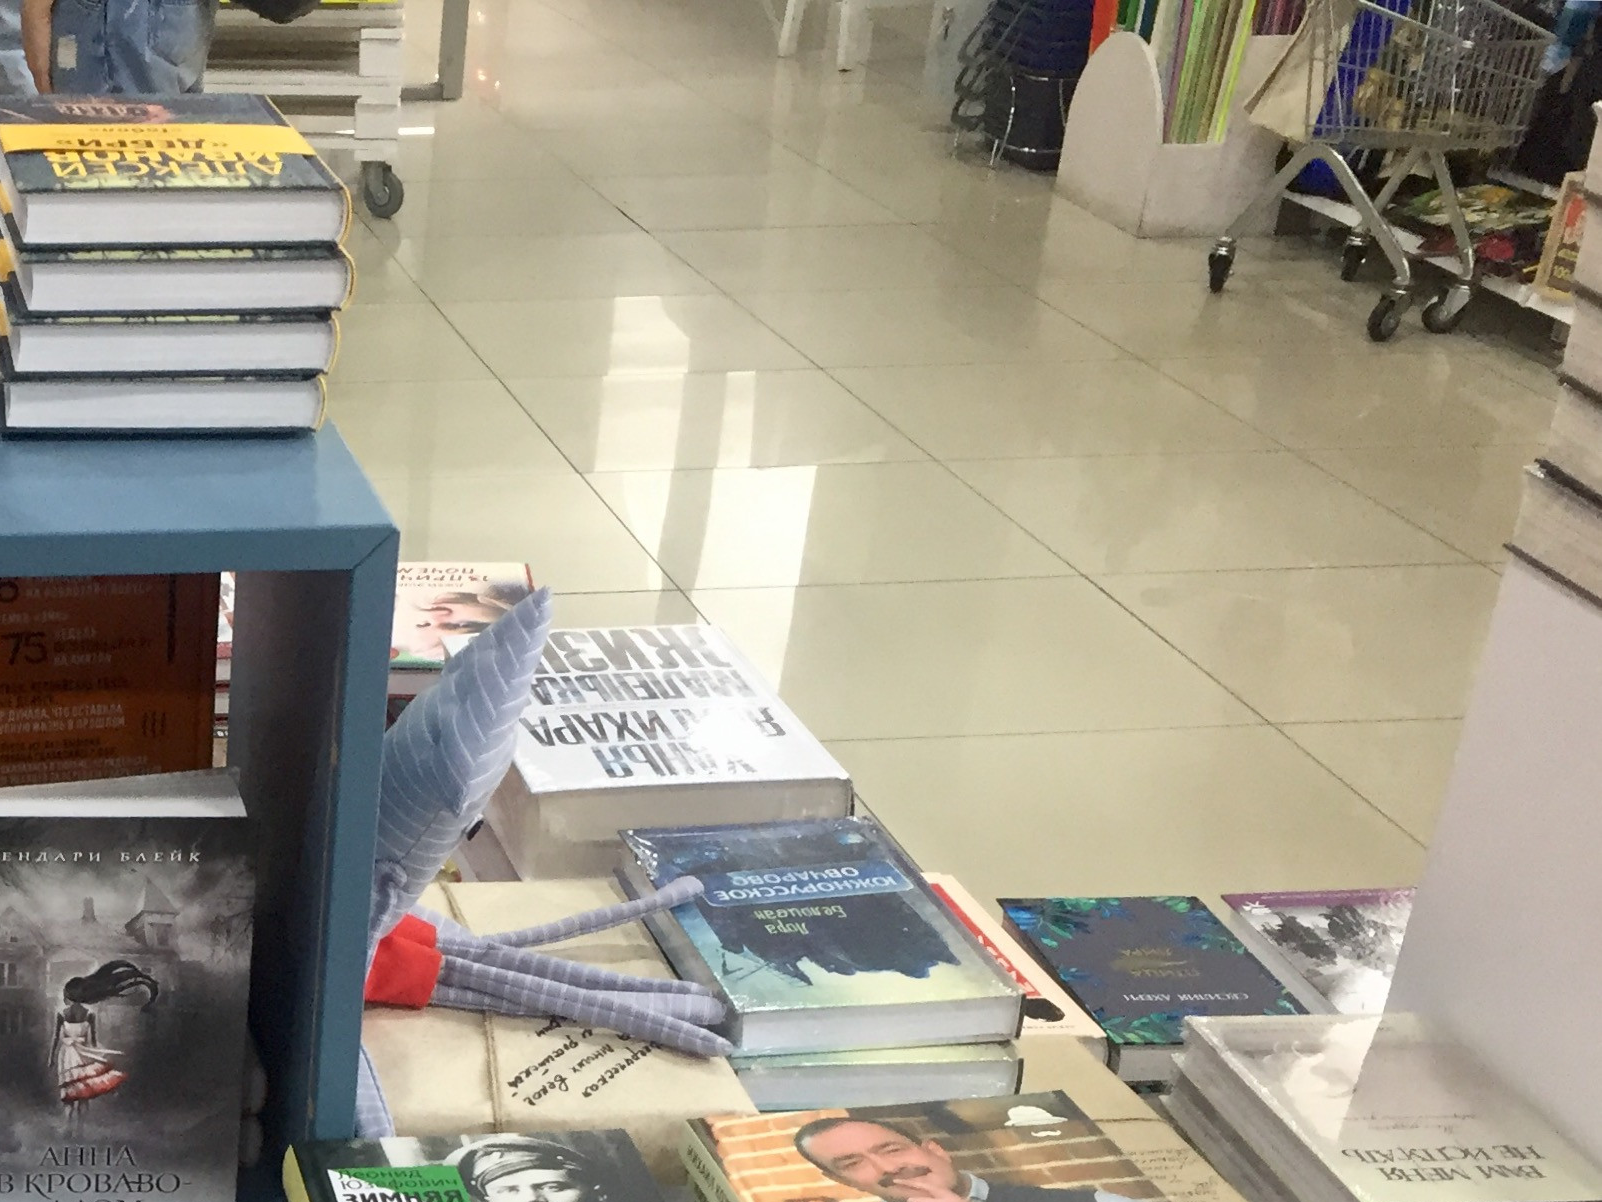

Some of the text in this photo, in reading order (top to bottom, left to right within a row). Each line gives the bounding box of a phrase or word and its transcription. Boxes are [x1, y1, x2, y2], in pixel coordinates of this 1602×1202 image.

[1, 631, 48, 665] 75
[534, 628, 733, 674] ЖИЗ
[529, 670, 757, 705] МАЛЕНЬКА
[120, 850, 202, 863] БЛЕЙК
[728, 866, 860, 887] ОВЧАРОВО
[713, 874, 897, 901] ЮЖНОРУССКОЕ
[764, 920, 810, 935] Лора
[40, 1145, 136, 1167] АННА
[1492, 1144, 1545, 1161] НЕ
[339, 1170, 422, 1179] Леонид
[1376, 1165, 1546, 1182] ВАМ МЕНЯ
